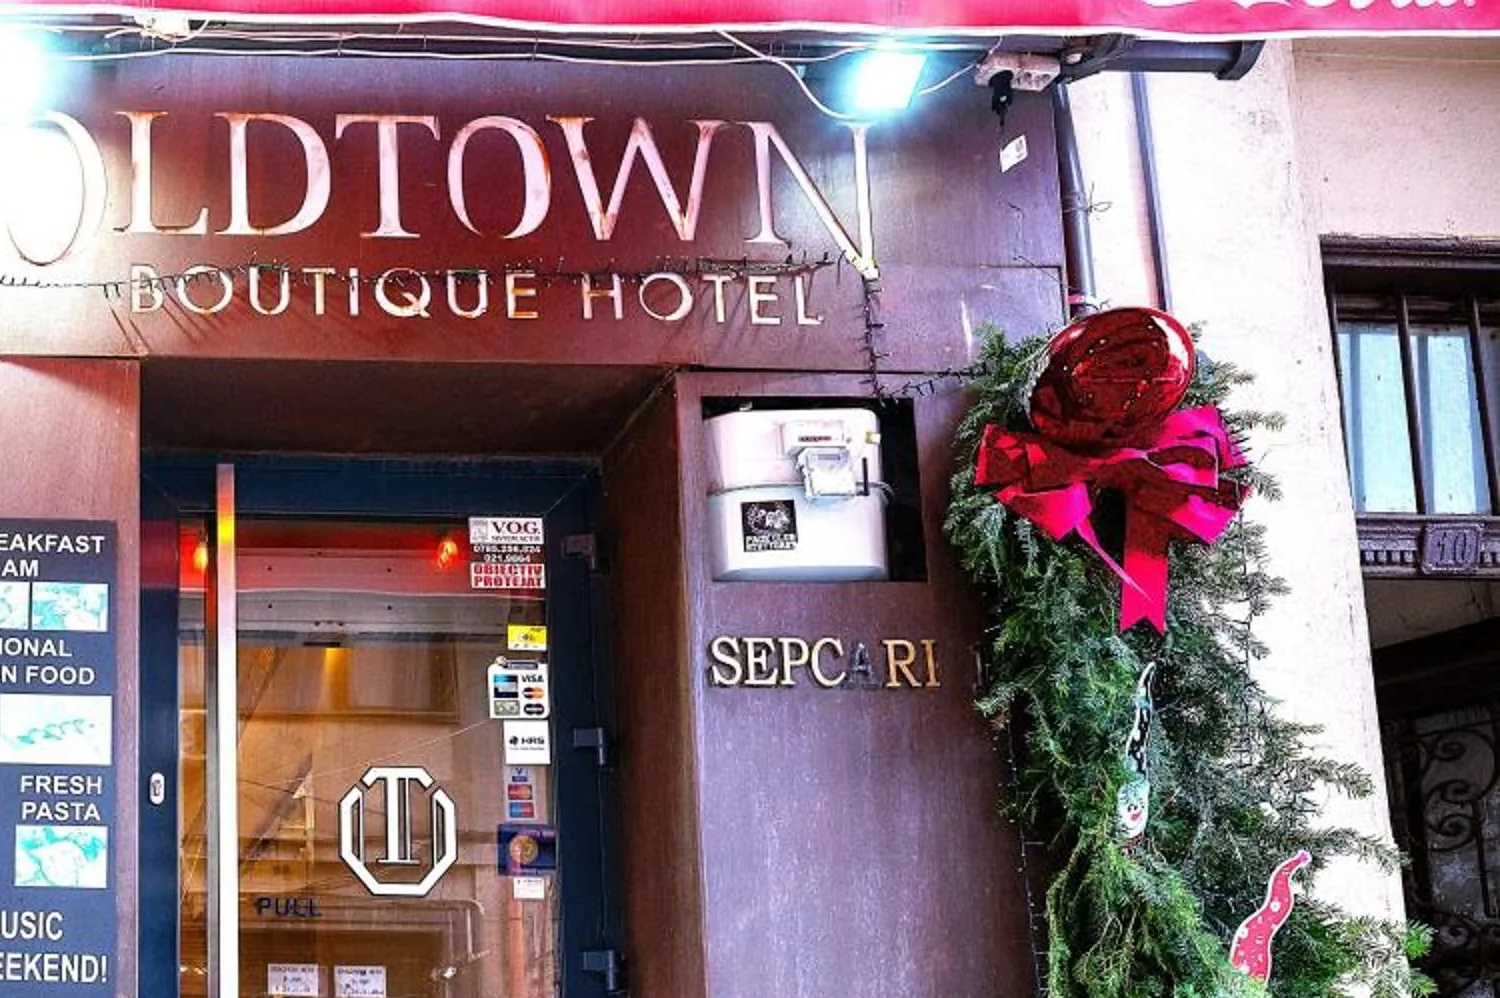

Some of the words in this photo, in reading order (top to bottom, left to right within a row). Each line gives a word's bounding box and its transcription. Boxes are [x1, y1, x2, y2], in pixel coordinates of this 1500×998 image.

[130, 262, 540, 319] BOUTIQUE
[582, 271, 823, 326] HOTEL
[1, 559, 39, 577] AM
[711, 635, 942, 690] SEPCARI
[25, 666, 95, 686] FOOD
[520, 674, 544, 683] VISA
[20, 775, 102, 795] FRESH
[21, 802, 100, 821] PASTA
[256, 896, 323, 918] PULL
